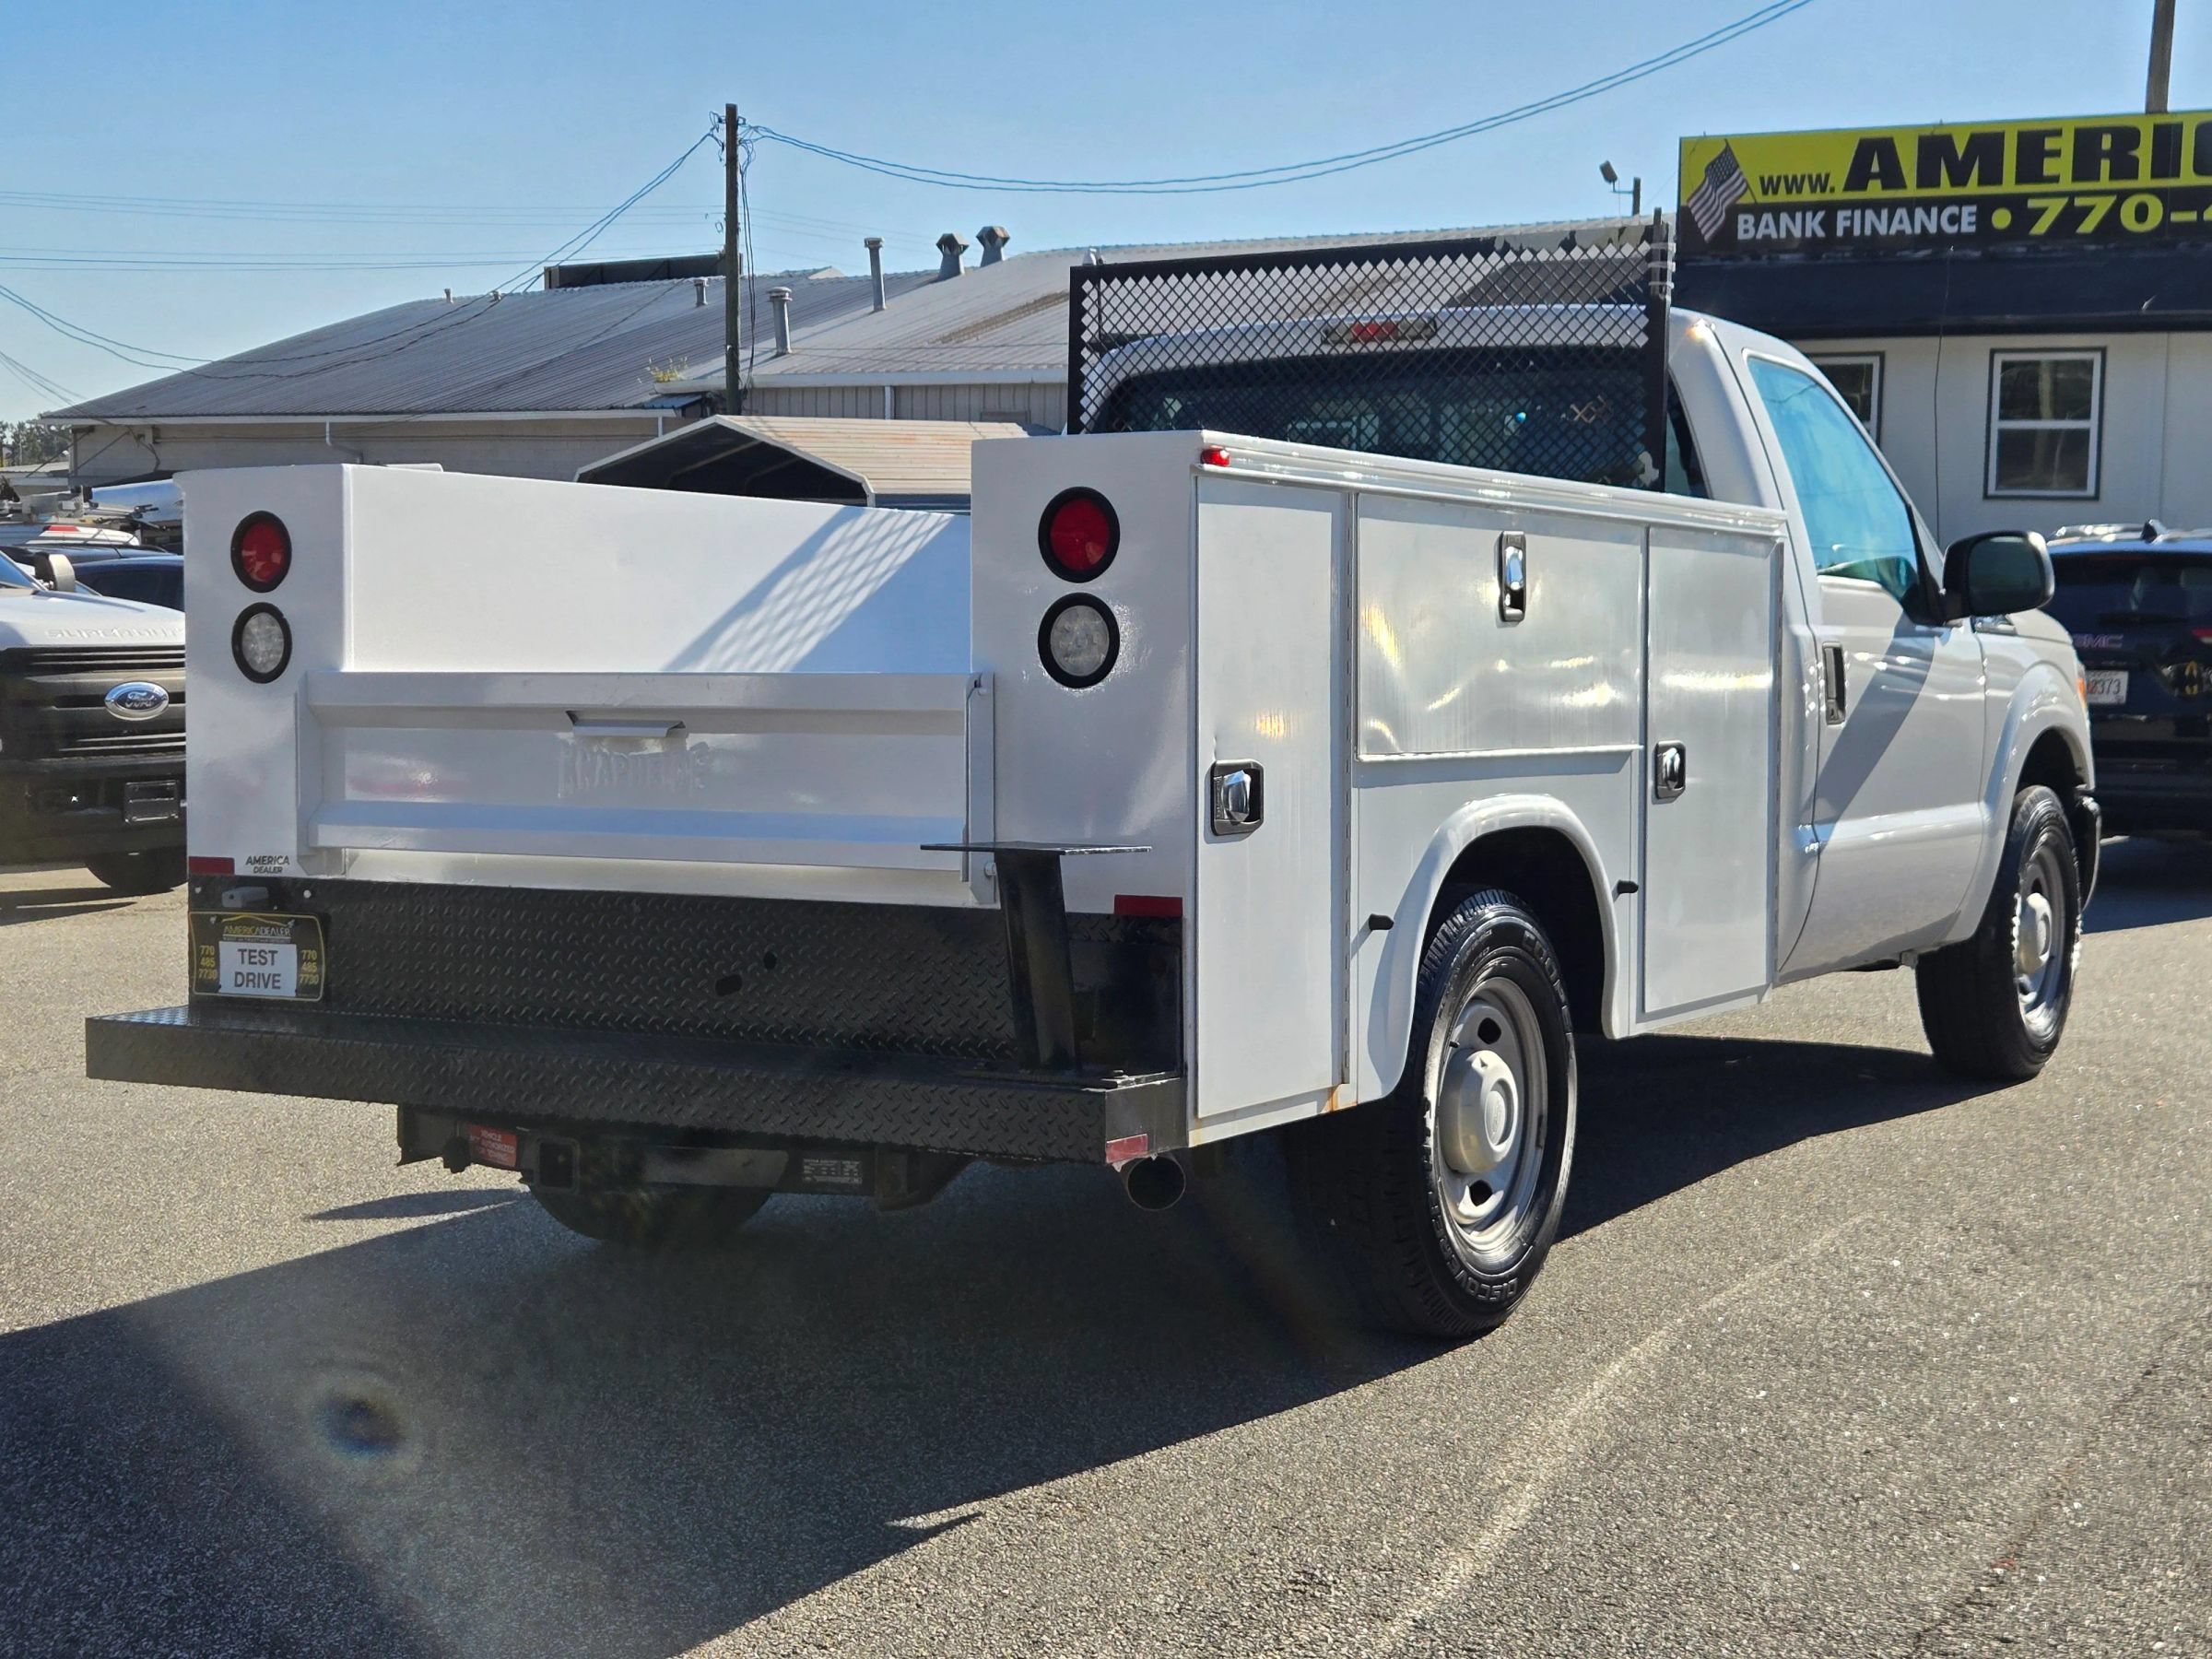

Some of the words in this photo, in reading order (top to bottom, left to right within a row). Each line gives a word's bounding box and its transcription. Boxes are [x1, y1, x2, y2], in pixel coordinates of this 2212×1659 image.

[1737, 210, 1826, 240] BANK
[1836, 205, 1978, 238] FINANCE
[245, 855, 290, 866] AMERICA
[253, 866, 284, 875] DEALER
[199, 945, 215, 956] 770
[300, 949, 317, 960] 770
[200, 957, 216, 968] 485
[237, 948, 278, 966] TEST
[234, 971, 281, 989] DRIVE
